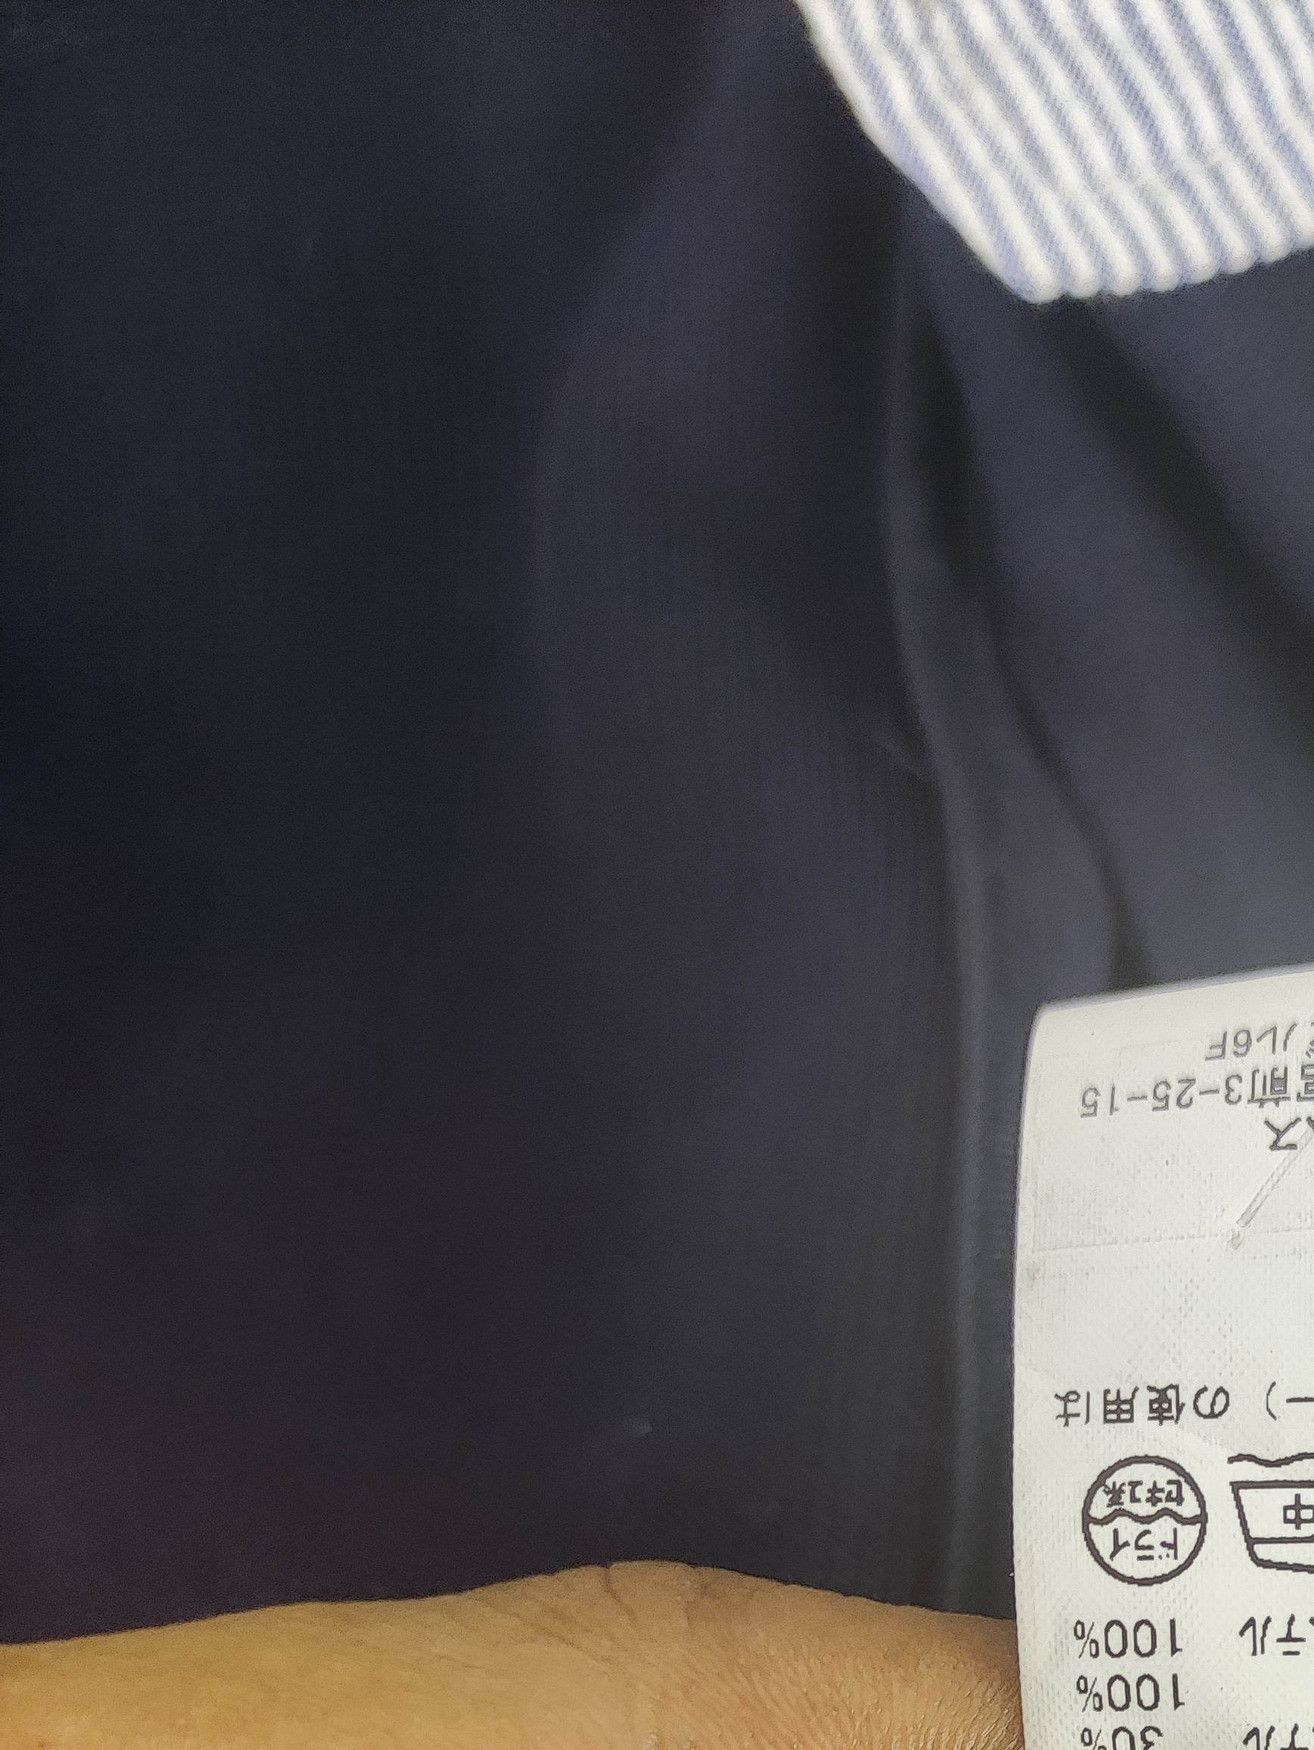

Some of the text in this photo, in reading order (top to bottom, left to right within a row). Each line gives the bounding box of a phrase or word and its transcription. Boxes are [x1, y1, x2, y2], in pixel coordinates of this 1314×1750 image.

[1111, 1527, 1179, 1560] ドライ
[1074, 1619, 1183, 1660] 100%
[1076, 1673, 1185, 1712] 100%
